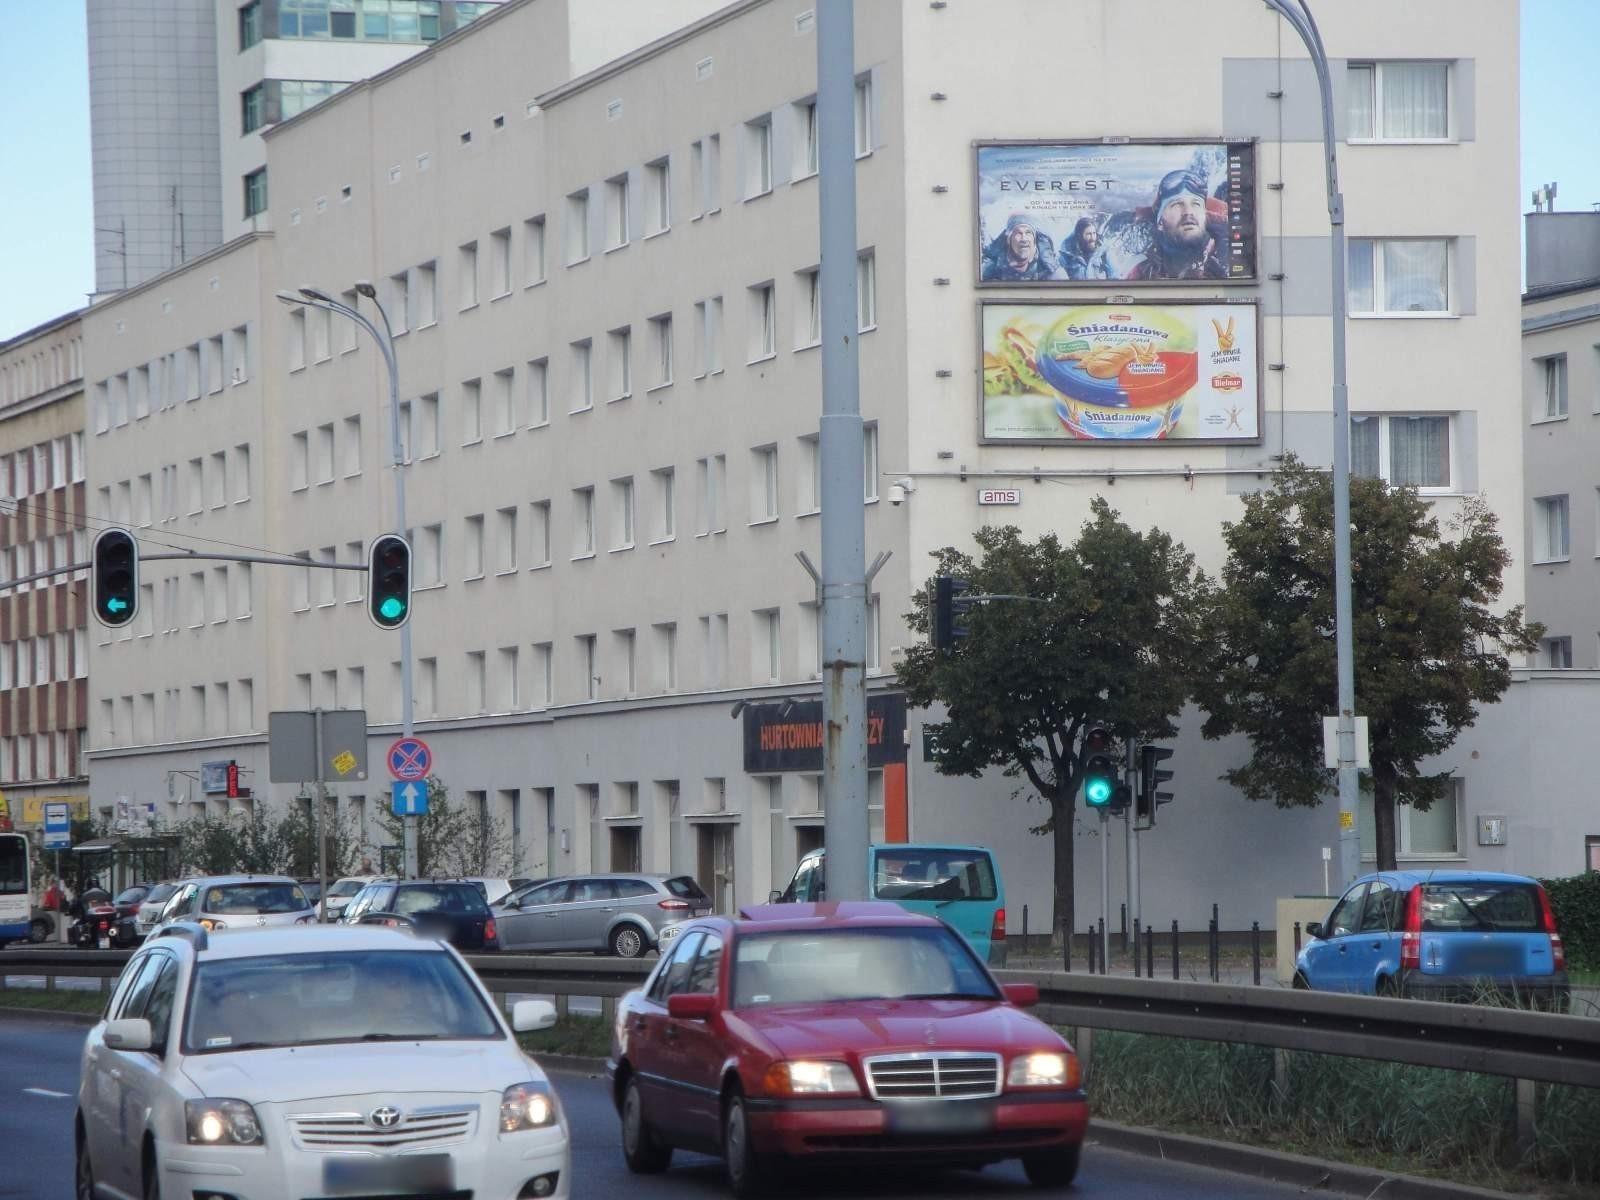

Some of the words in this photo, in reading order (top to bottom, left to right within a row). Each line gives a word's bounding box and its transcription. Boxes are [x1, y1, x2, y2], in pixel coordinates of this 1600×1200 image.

[1000, 180, 1114, 191] EVEREST
[1067, 324, 1169, 339] Śniadaniowa
[1084, 408, 1152, 422] Śniadaniowa
[984, 491, 1015, 502] ams
[760, 722, 824, 751] HURTOWNIA
